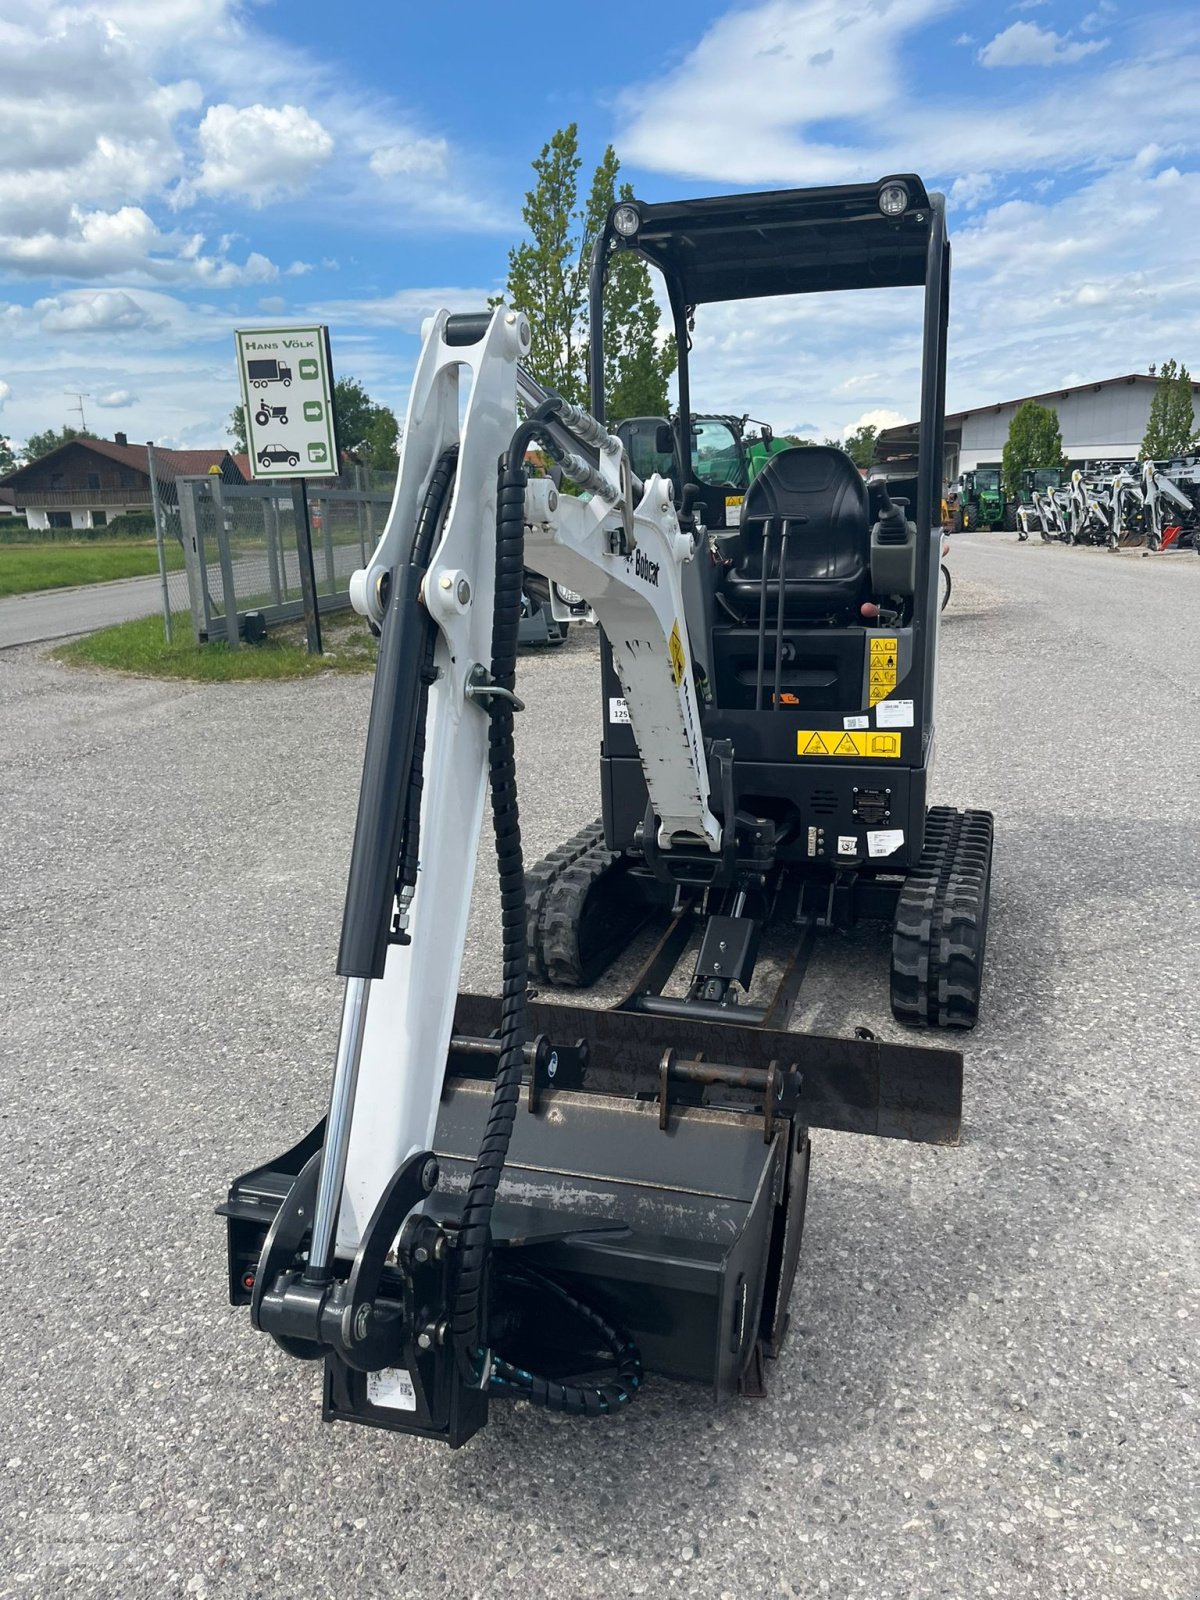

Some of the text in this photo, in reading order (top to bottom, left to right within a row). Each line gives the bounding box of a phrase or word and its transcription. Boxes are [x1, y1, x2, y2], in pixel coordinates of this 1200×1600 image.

[245, 339, 314, 350] HANS VÖLK
[635, 548, 660, 587] Bobcat
